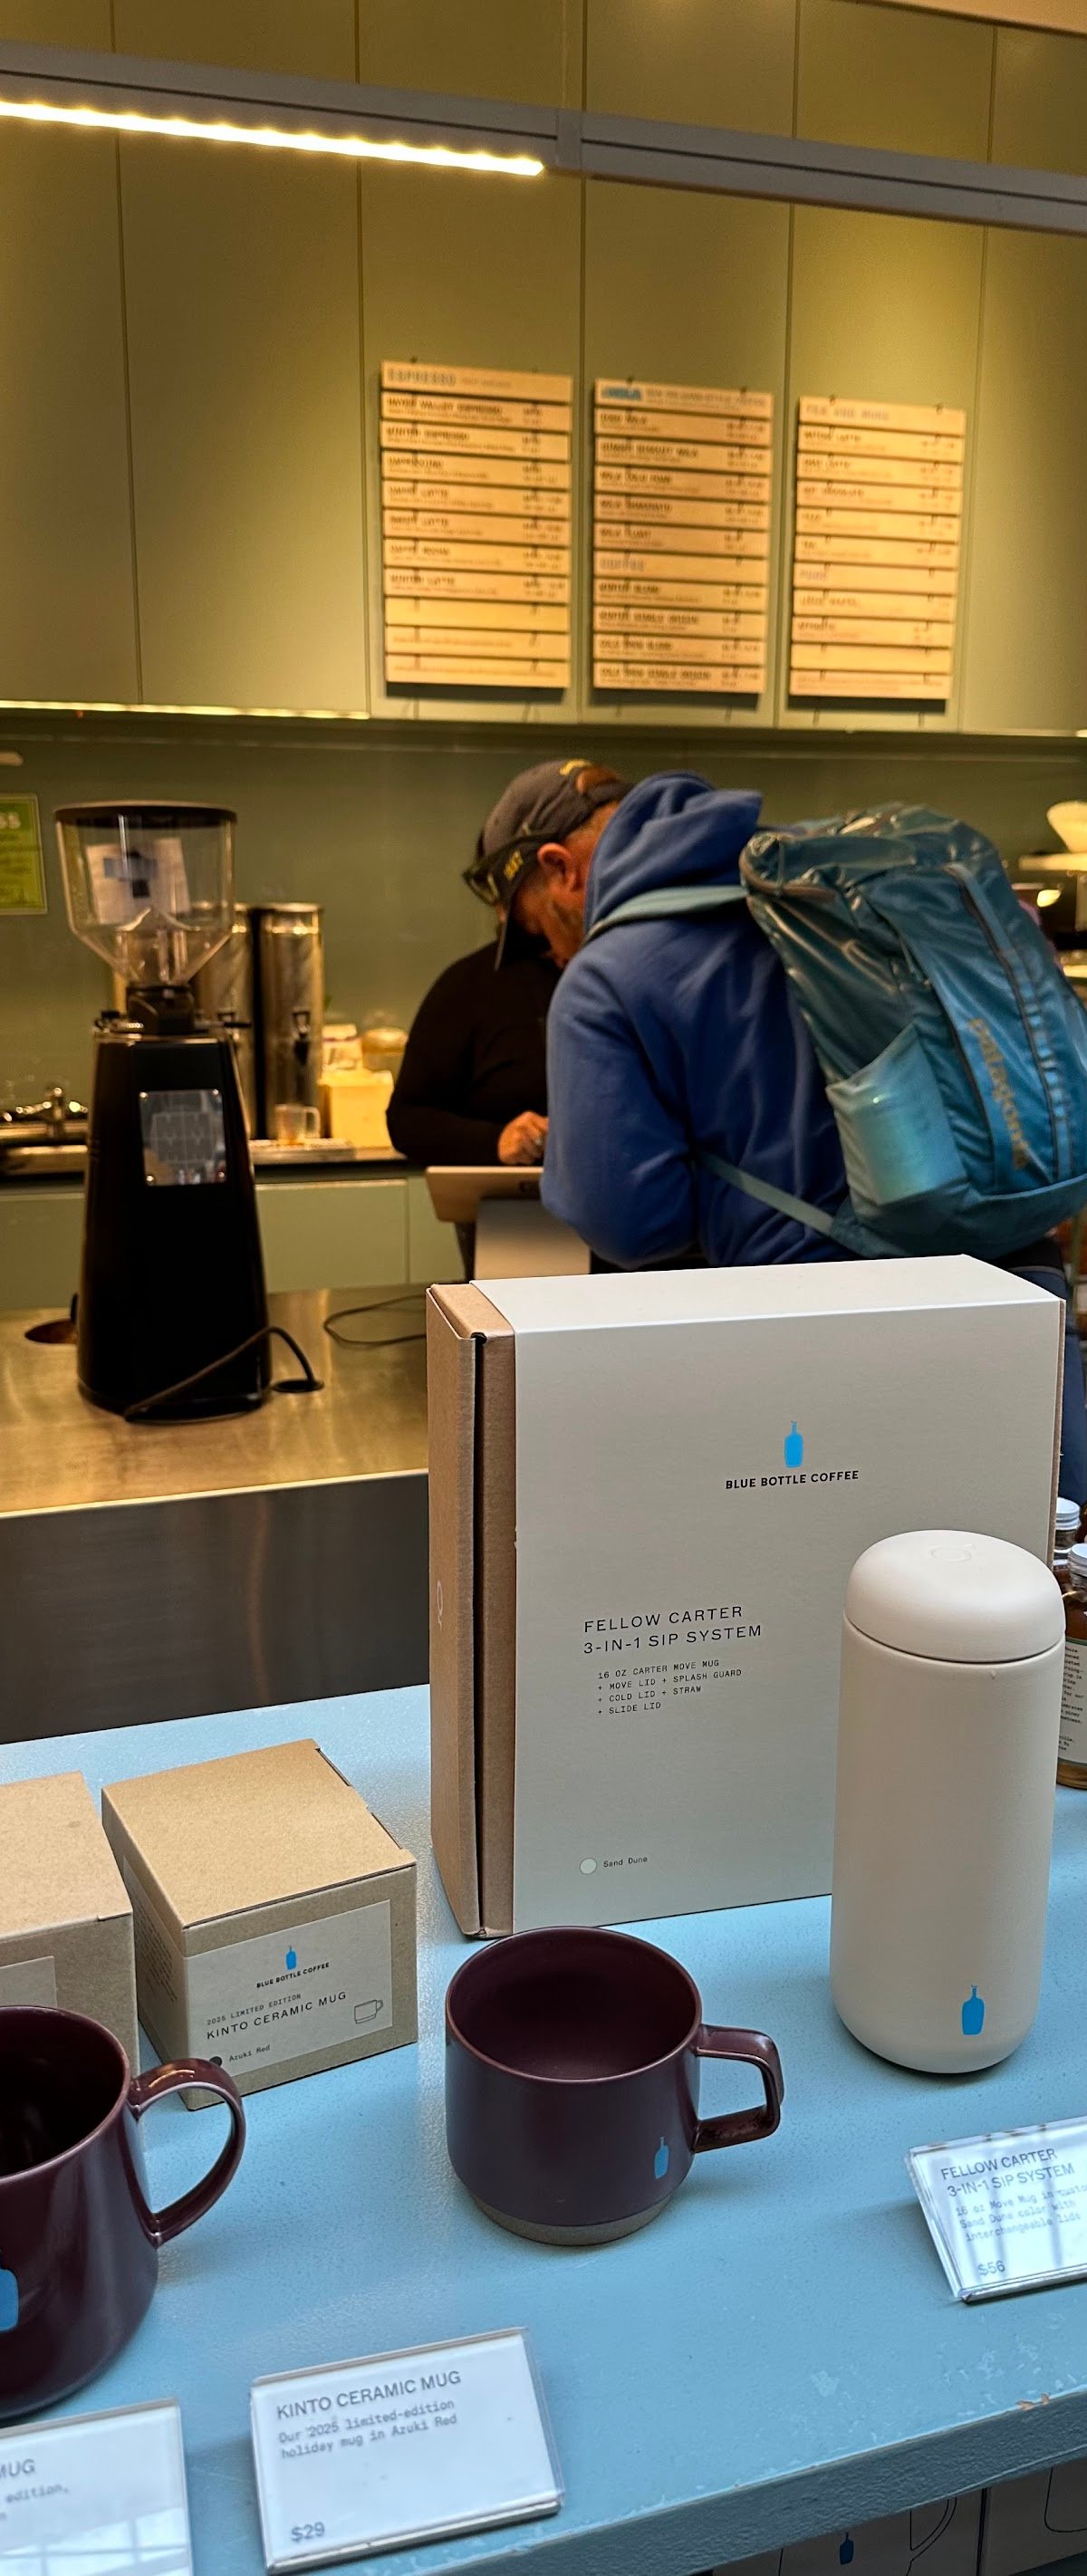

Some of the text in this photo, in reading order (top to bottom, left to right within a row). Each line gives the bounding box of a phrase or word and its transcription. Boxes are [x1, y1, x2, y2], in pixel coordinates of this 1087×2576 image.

[726, 1470, 859, 1489] BLUE BOTTLE COFFEE
[584, 1606, 743, 1633] FELLOW CARTER
[583, 1625, 761, 1654] 3-IN-1 SIP SYSTEM
[598, 1659, 719, 1679] 16 OZ CARTER MOVE MUG
[609, 1680, 632, 1690] MOVE
[639, 1677, 656, 1687] LID
[673, 1672, 707, 1683] SPLASH
[713, 1668, 742, 1678] GUARD
[609, 1693, 632, 1703] COLD
[638, 1690, 656, 1699] LID
[673, 1685, 702, 1696] STRAW
[609, 1704, 638, 1715] SLIDE
[643, 1701, 661, 1711] LID
[603, 1859, 623, 1868] Sand
[256, 1962, 330, 1989] BLUE BOTTLE COFFEE
[207, 1993, 302, 2025] 2025 LIMITED EDITION
[207, 1991, 347, 2040] KINTO CERAMIC MUG
[228, 2044, 271, 2062] Azuki Red
[940, 2148, 1058, 2181] FELLOW CARTER
[947, 2162, 1076, 2197] 3-IN-1 SIP SYSTEM
[959, 2200, 1077, 2229] Sand Dune color with
[989, 2199, 1015, 2210] Move
[1017, 2194, 1038, 2205] Mug
[966, 2212, 1082, 2242] interchangeable lids
[977, 2260, 1006, 2276] $56
[276, 2370, 462, 2420] KINTO CERAMIC MUG
[279, 2399, 455, 2444] Our 2025 limited-edition
[282, 2414, 457, 2459] holiday mug in Azuki Red
[291, 2521, 325, 2543] $29
